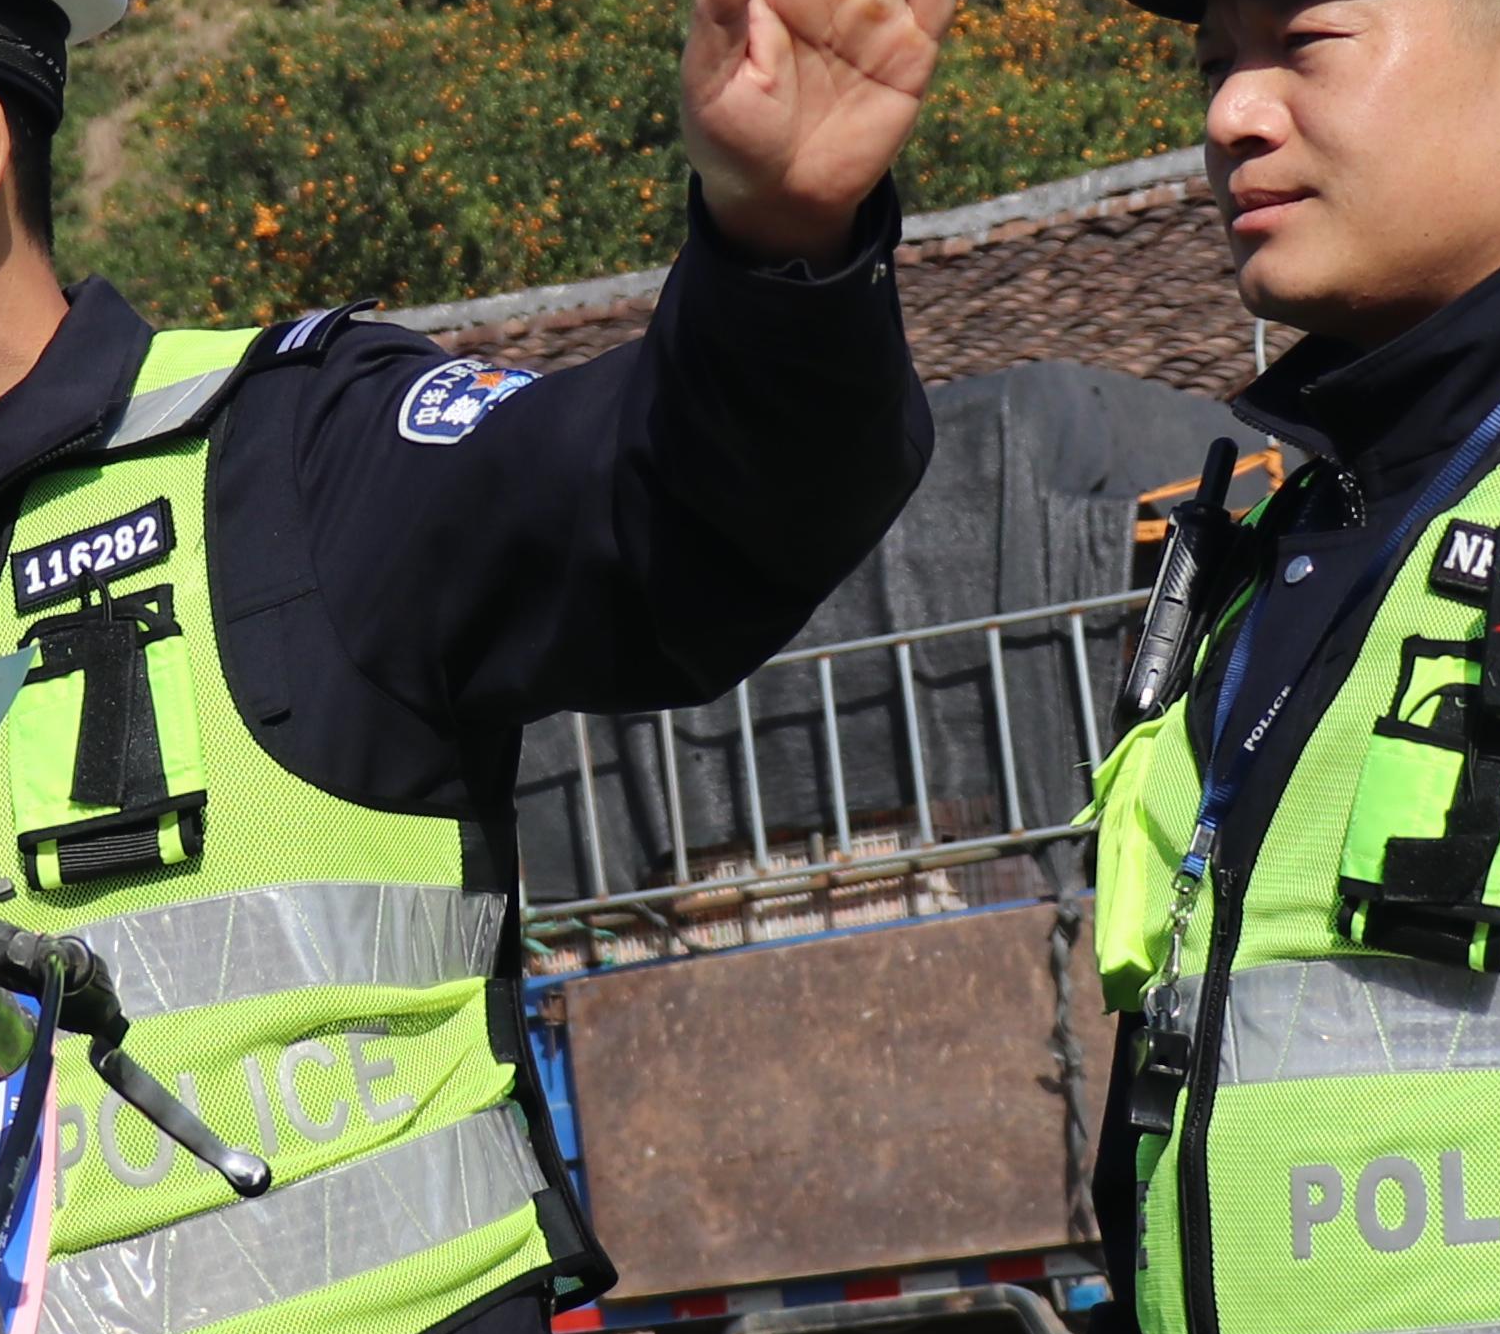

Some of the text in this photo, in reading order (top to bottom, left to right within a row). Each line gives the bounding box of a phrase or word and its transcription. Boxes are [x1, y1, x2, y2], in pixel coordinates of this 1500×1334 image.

[24, 515, 158, 595] 116282
[1243, 685, 1293, 753] POLICE
[55, 1027, 420, 1212] POLICE
